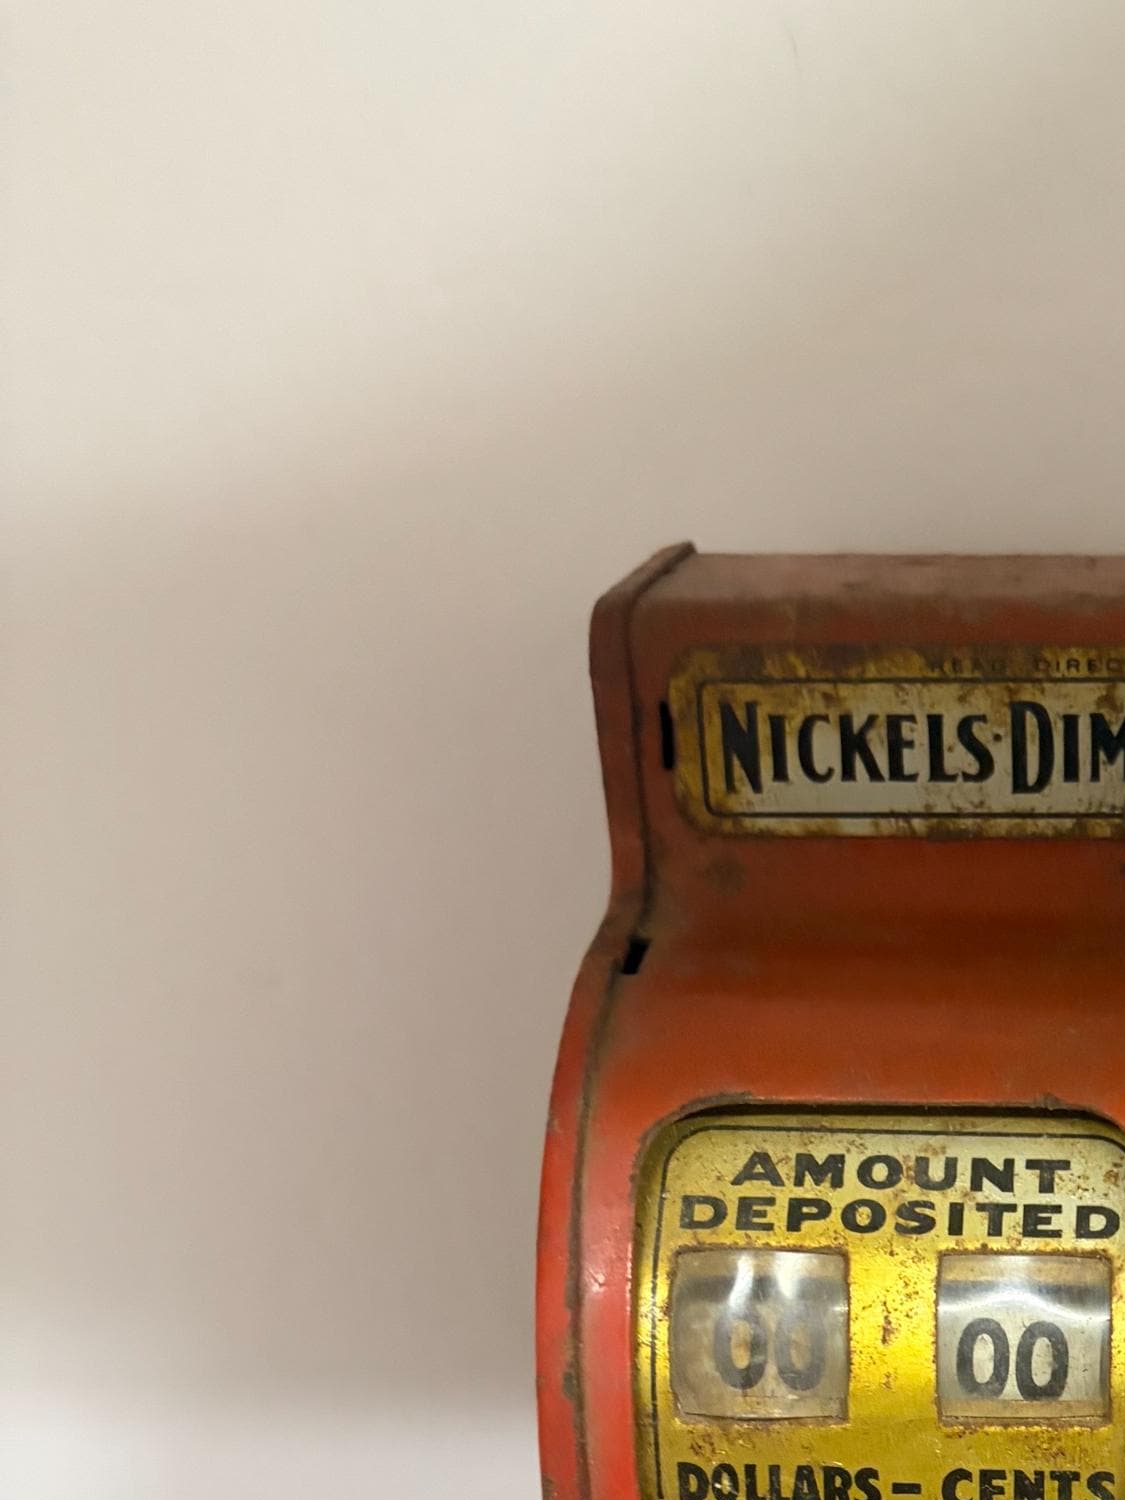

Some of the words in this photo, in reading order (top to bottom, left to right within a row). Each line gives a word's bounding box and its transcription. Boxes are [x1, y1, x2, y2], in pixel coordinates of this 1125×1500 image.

[730, 1151, 1071, 1195] AMOUNT
[677, 1194, 1121, 1240] DEPOSITED
[956, 1317, 1070, 1402] 00
